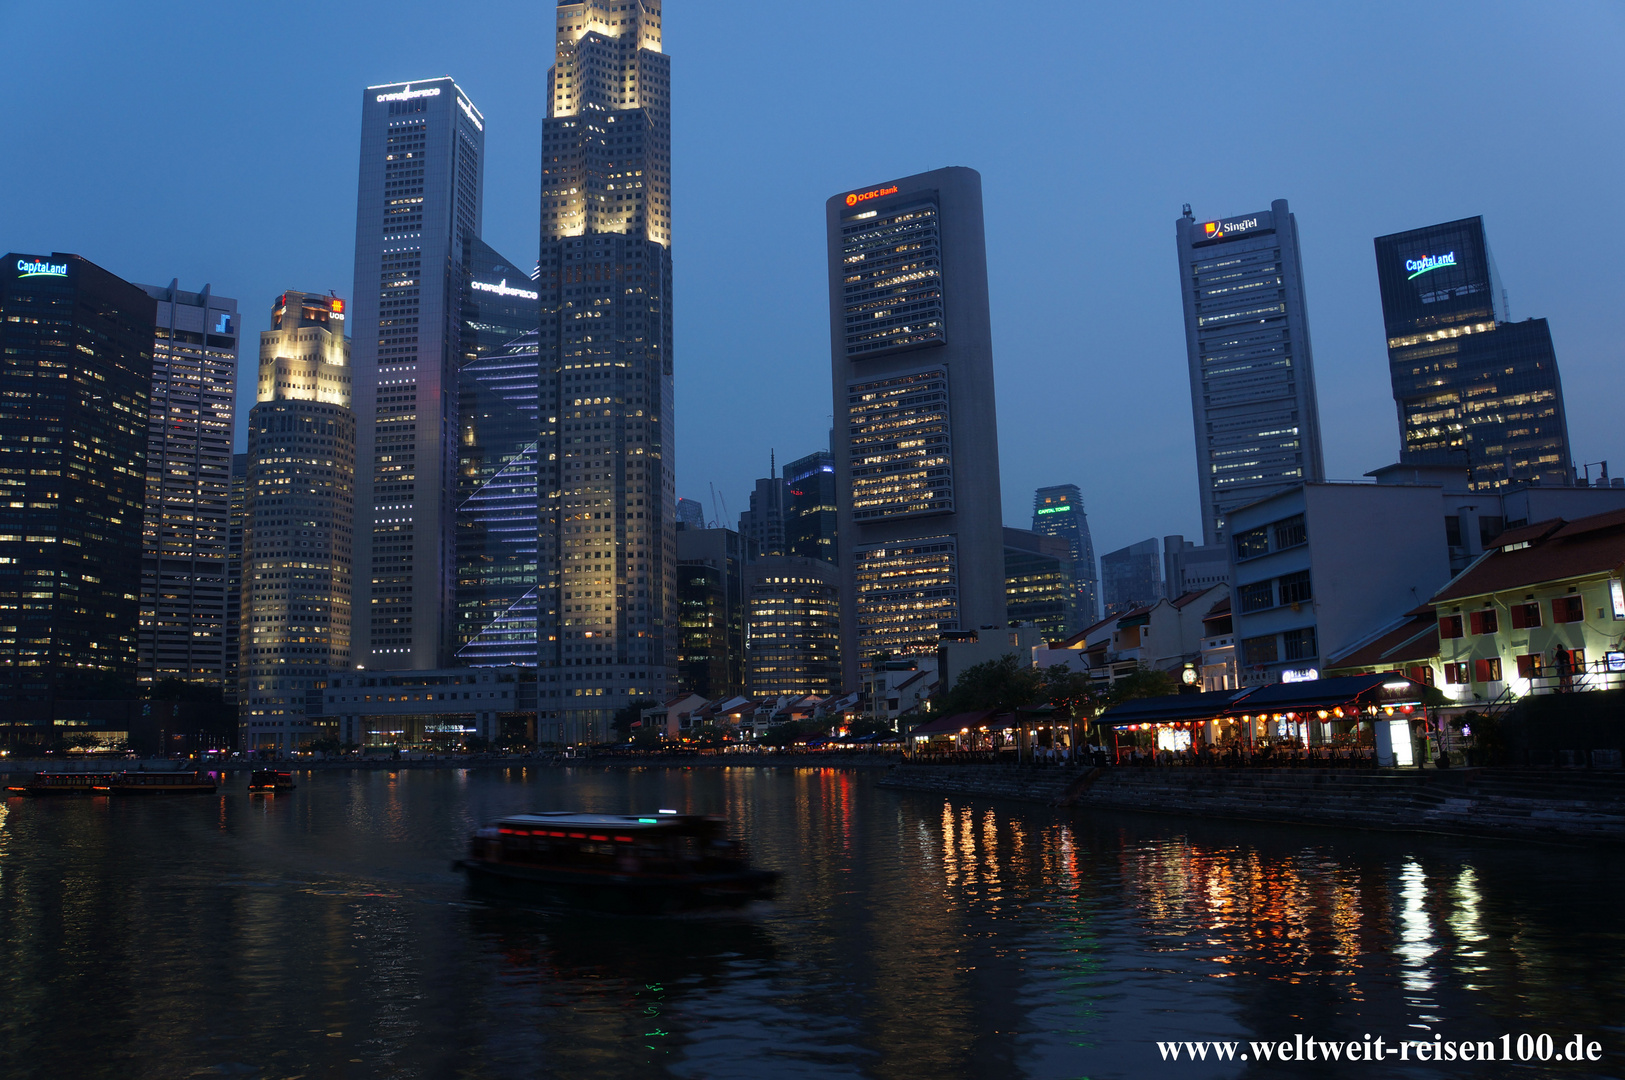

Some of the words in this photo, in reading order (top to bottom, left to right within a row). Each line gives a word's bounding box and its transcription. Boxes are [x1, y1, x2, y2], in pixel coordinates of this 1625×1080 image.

[858, 190, 879, 201] OCBC
[880, 185, 898, 196] Bank
[1224, 218, 1257, 232] SingTel
[17, 259, 67, 274] CapitaLand
[1406, 251, 1454, 272] CapitaLand
[329, 312, 345, 321] UOB
